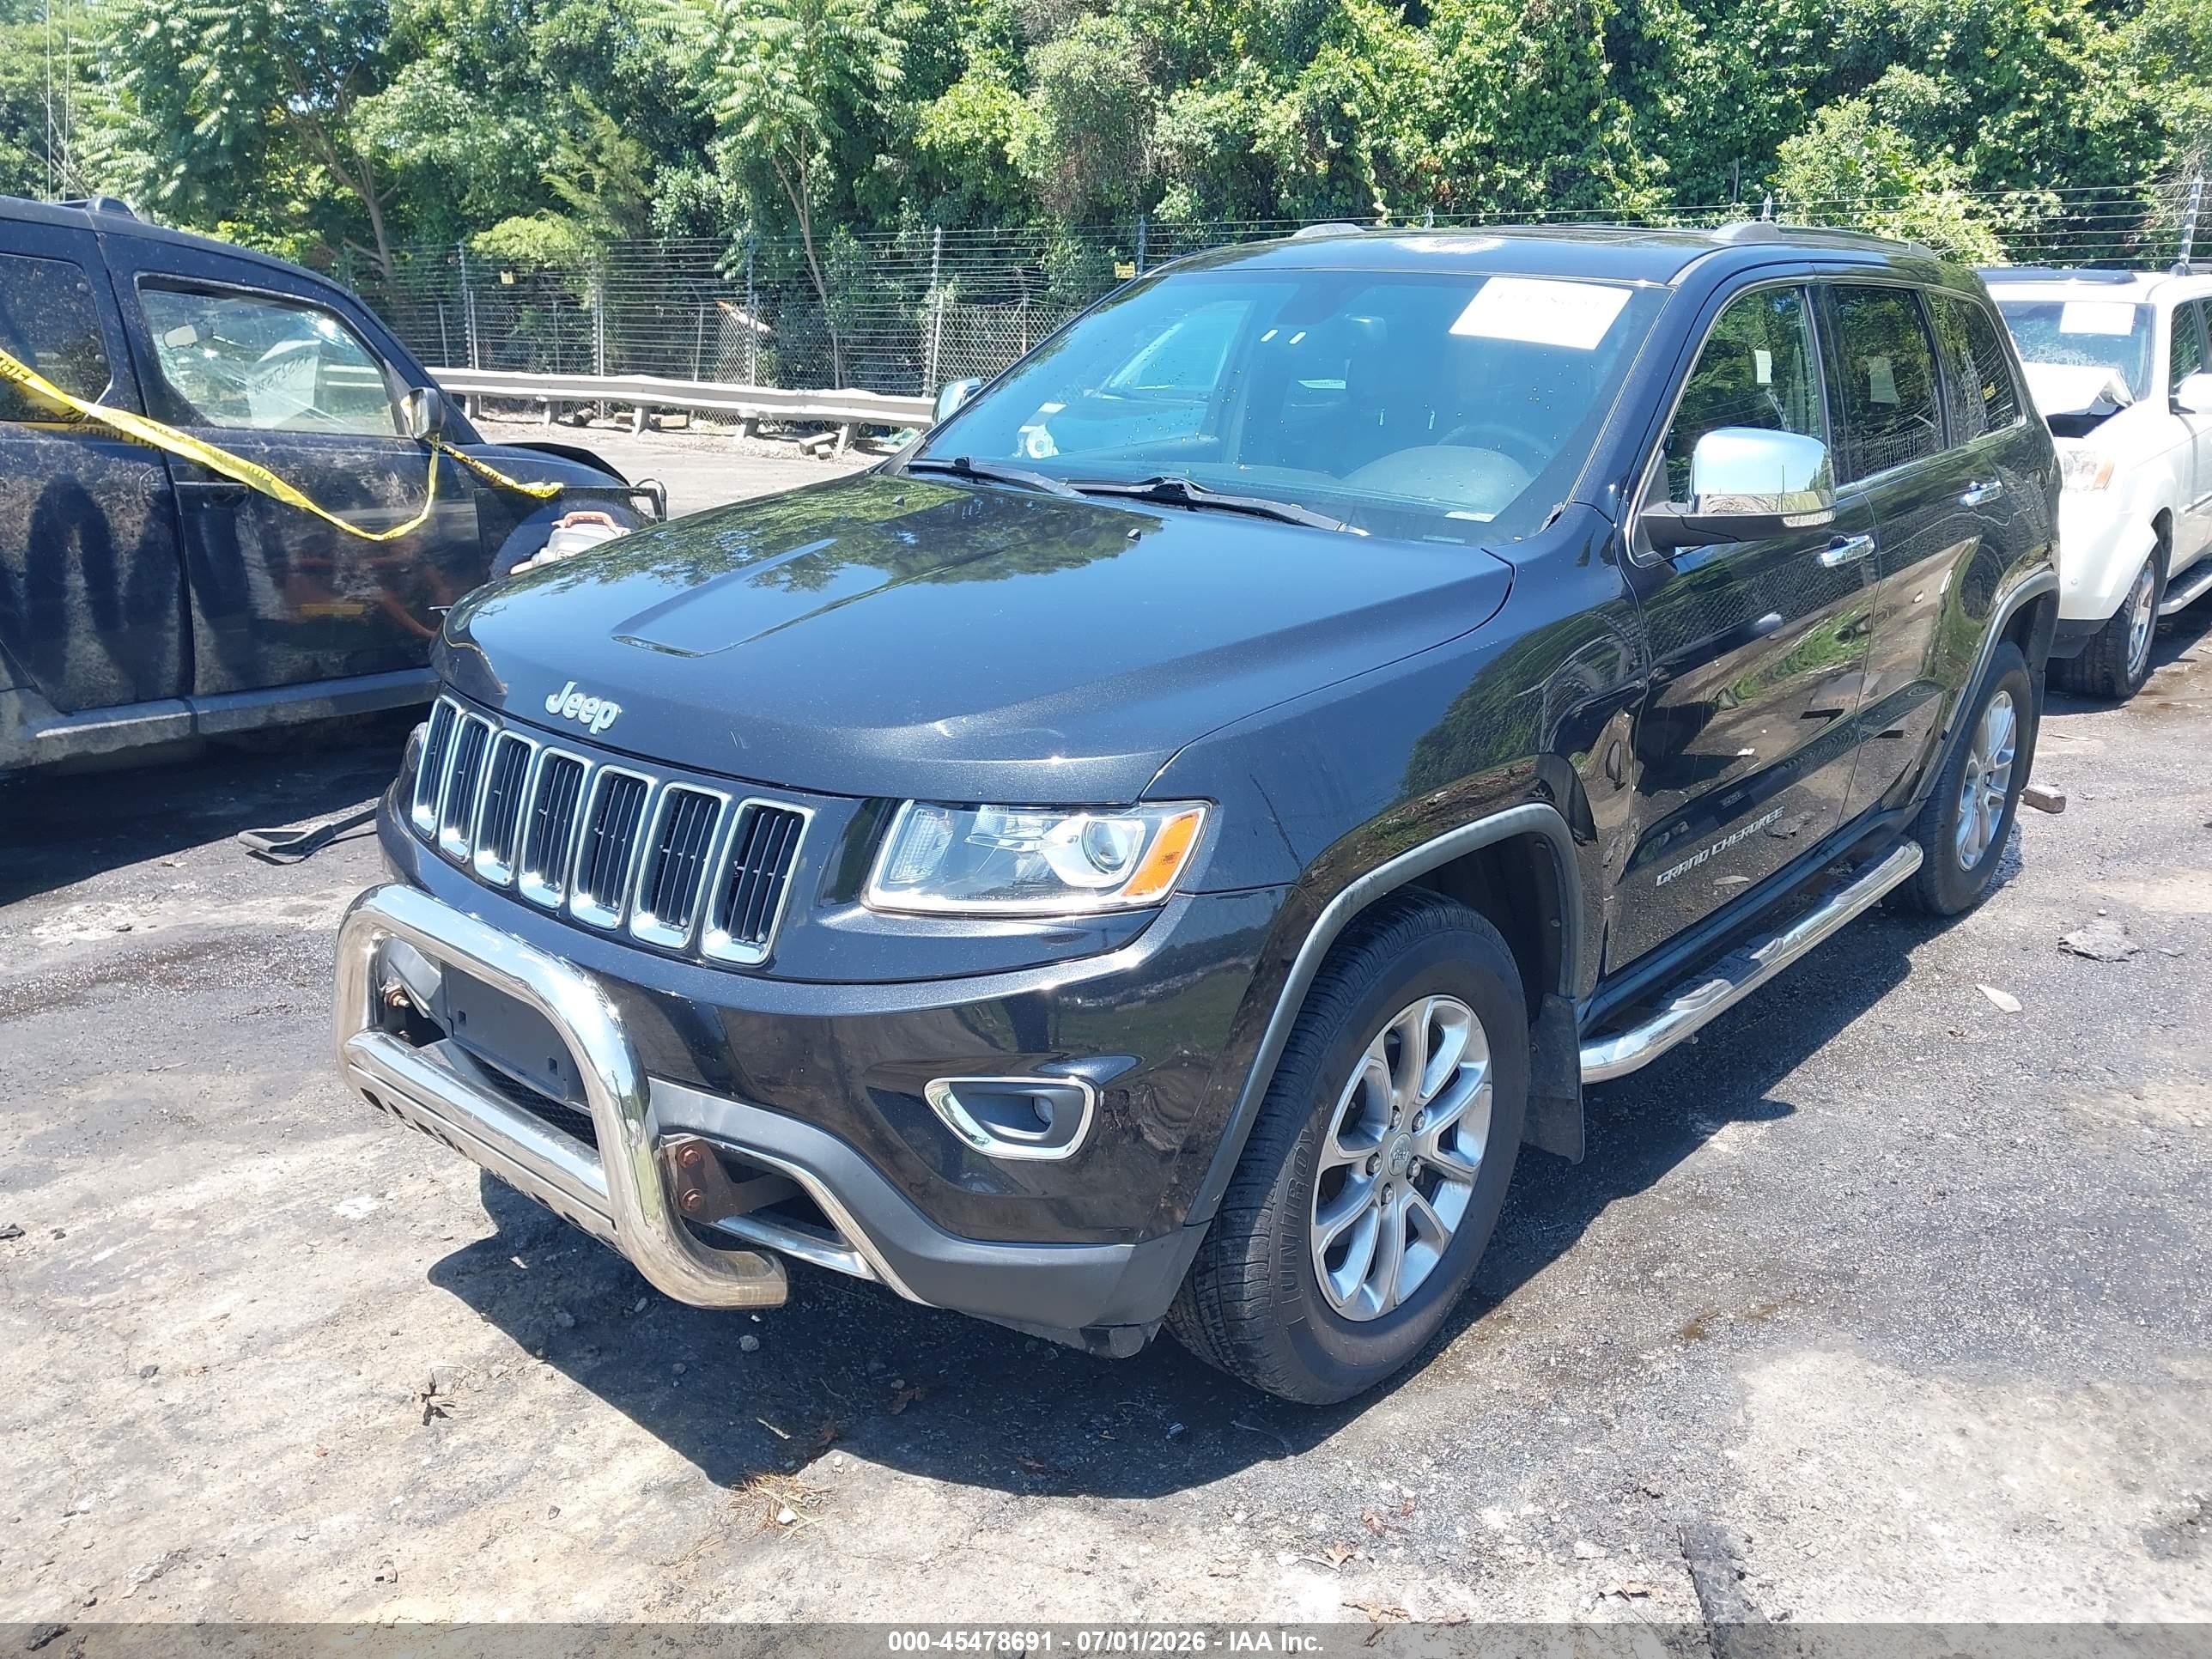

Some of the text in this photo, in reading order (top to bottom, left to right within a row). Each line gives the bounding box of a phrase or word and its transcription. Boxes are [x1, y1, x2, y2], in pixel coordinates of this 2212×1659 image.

[0, 357, 33, 383] FIR
[545, 681, 619, 735] Jeep
[1656, 805, 1785, 887] GRAND CHEROKEE
